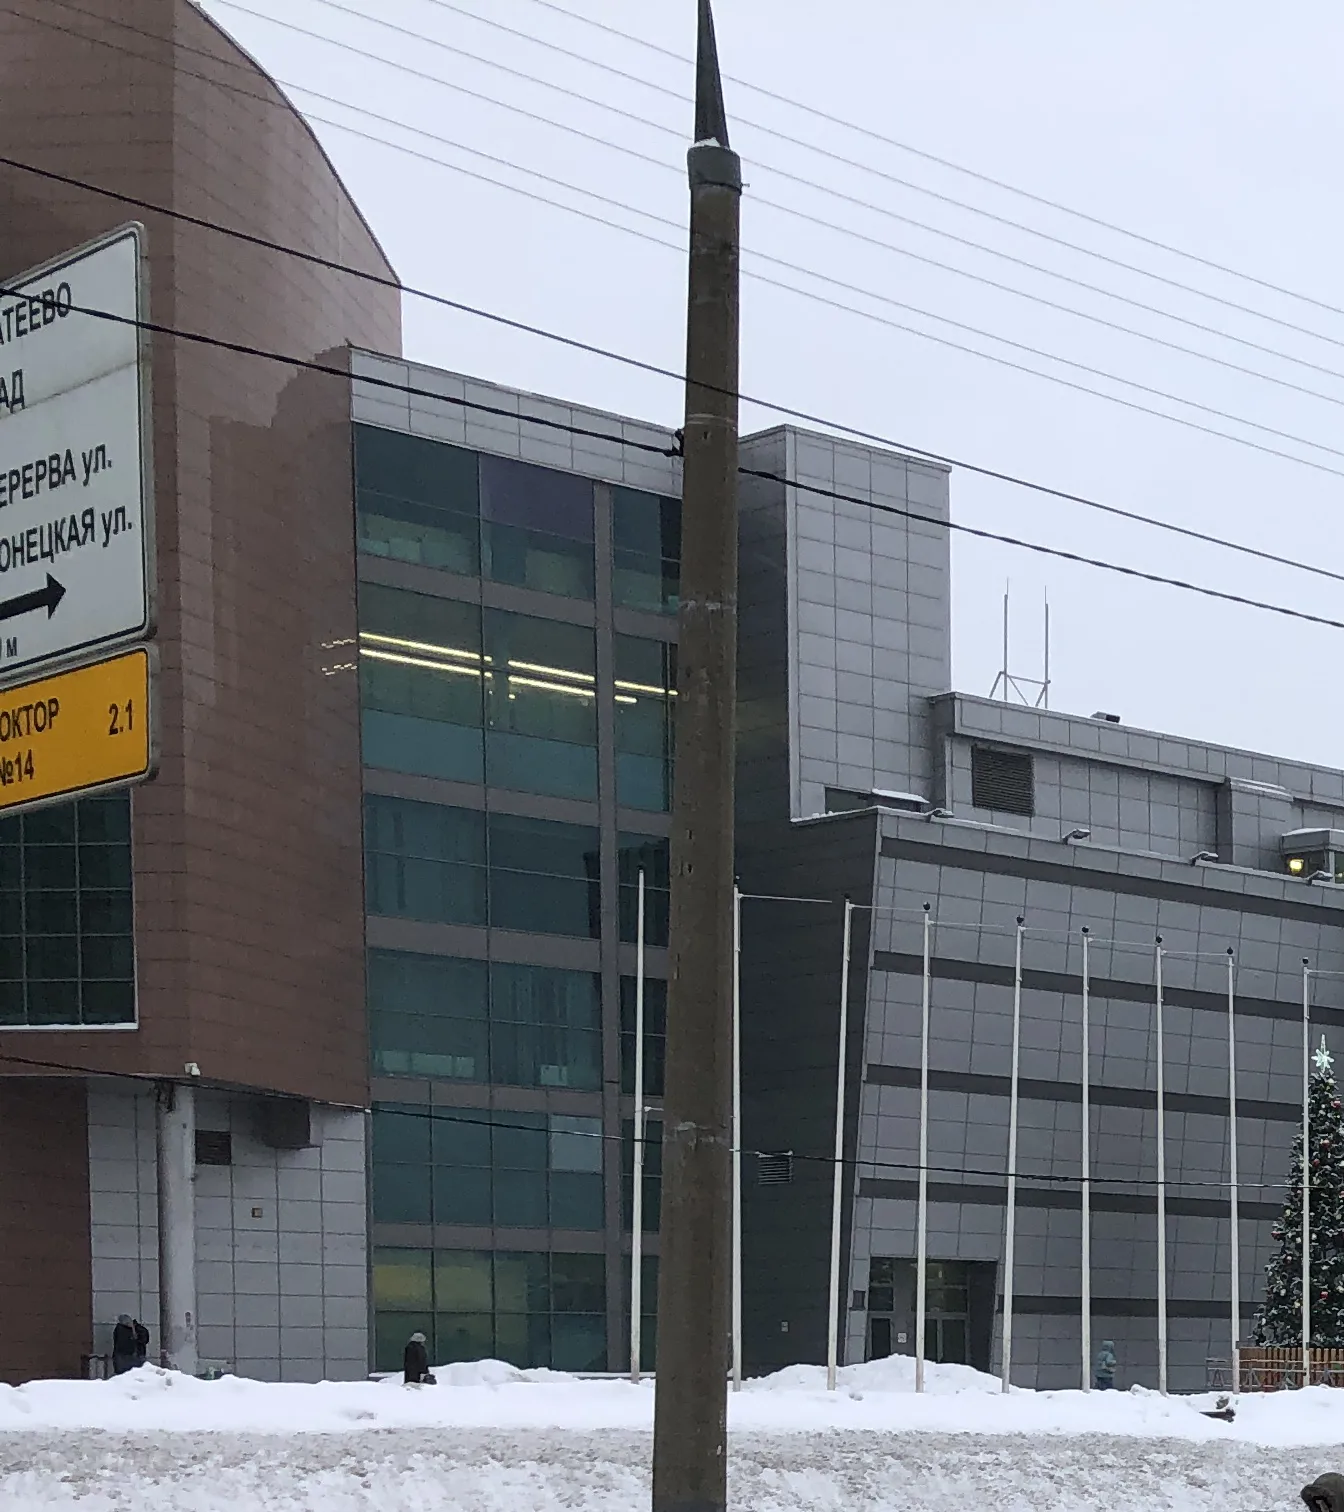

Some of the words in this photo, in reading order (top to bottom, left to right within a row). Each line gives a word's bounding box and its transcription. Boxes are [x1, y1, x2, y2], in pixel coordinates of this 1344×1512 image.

[0, 282, 72, 345] ТЕЕВО
[81, 443, 112, 487] ул.
[0, 506, 95, 573] ОНЕЦКАЯ
[101, 505, 132, 548] ул.
[0, 697, 60, 742] ОКТОР
[108, 698, 133, 736] 2.1
